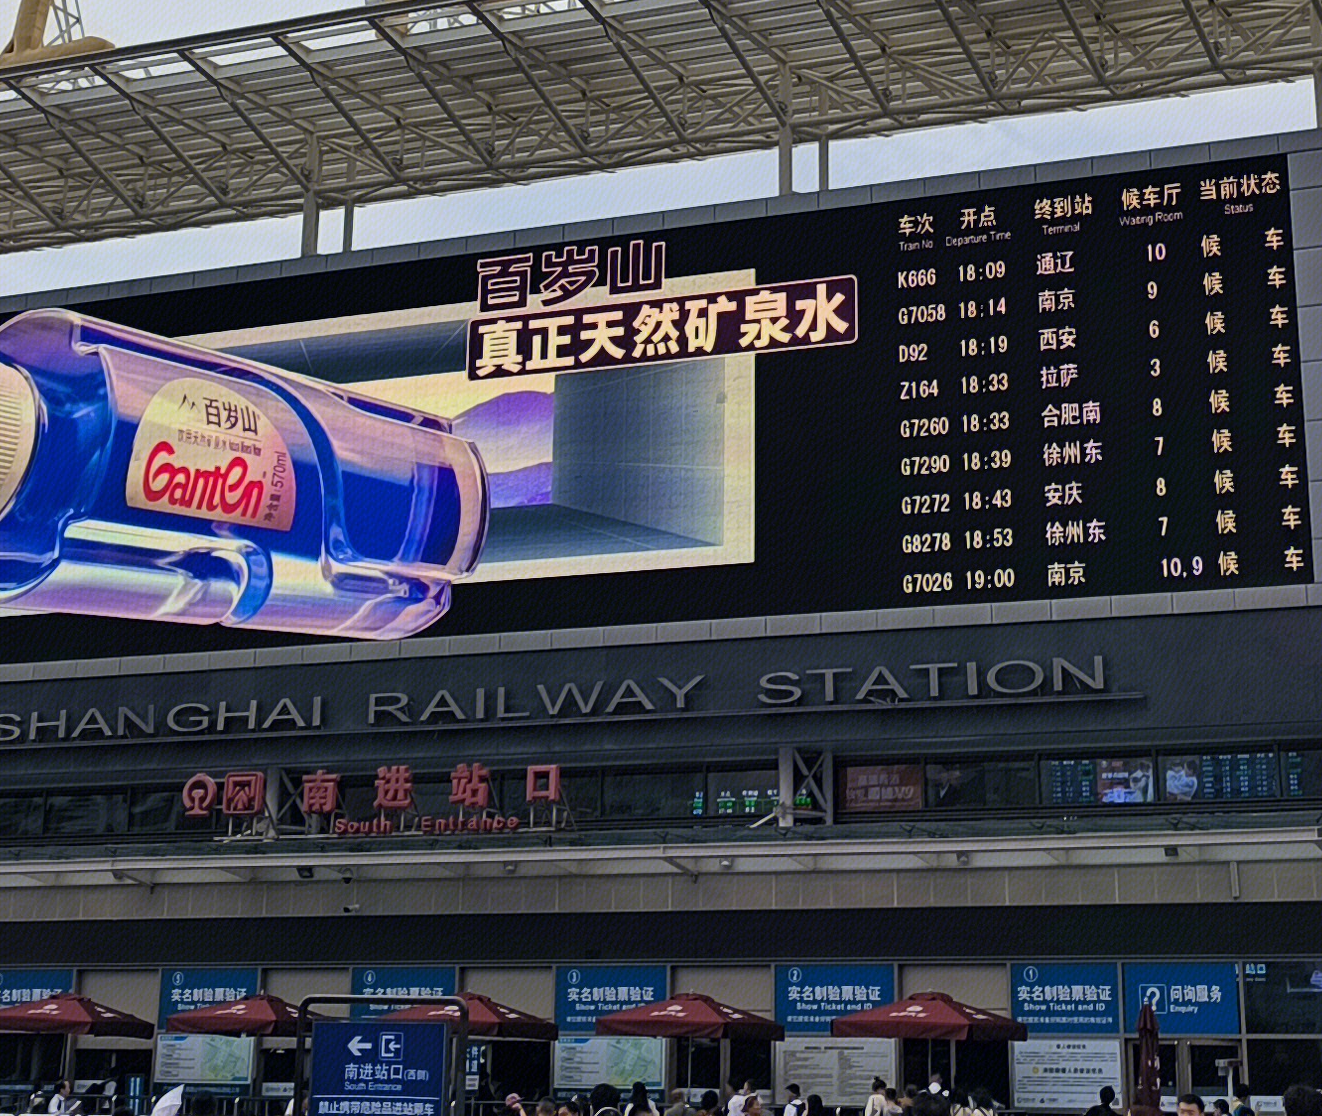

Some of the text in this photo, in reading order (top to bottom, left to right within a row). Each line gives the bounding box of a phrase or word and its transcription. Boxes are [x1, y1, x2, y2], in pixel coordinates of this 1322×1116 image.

[1200, 171, 1280, 199] 当前状态
[1035, 193, 1092, 219] 终到站
[1122, 183, 1181, 213] 候车厅
[960, 205, 996, 229] 开点
[1156, 212, 1182, 222] Room
[1225, 204, 1253, 214] Status
[899, 213, 933, 236] 车次
[1042, 222, 1079, 234] Terminal
[1148, 243, 1165, 261] 10
[959, 261, 1005, 281] 18:09
[1037, 251, 1074, 274] 通辽
[477, 240, 666, 314] 百岁山
[898, 268, 935, 288] K666
[1148, 281, 1157, 299] 9
[959, 298, 1005, 318] 18:14
[1039, 288, 1075, 313] 南京
[899, 304, 945, 324] G7058
[475, 284, 850, 377] 真正天然矿泉水
[1039, 326, 1076, 351] 西安
[1150, 320, 1159, 338] 6
[899, 344, 927, 362] D92
[961, 336, 1007, 356] 18:19
[1040, 364, 1078, 389] 拉萨
[1151, 359, 1160, 376] 3
[900, 380, 938, 399] Z164
[962, 373, 1008, 393] 18:33
[203, 397, 258, 435] 百岁山
[1042, 401, 1100, 428] 合肥南
[1153, 398, 1162, 416] 8
[901, 417, 948, 437] G7260
[963, 411, 1009, 432] 18:33
[1043, 439, 1102, 466] 徐州东
[1155, 437, 1163, 455] 7
[901, 455, 949, 475] G7290
[963, 450, 1011, 470] 18:39
[1045, 481, 1082, 506] 安庆
[1157, 478, 1166, 496] 8
[902, 494, 950, 514] G7272
[964, 489, 1011, 510] 18:43
[1046, 519, 1106, 545] 徐州东
[1159, 517, 1167, 536] 7
[903, 533, 950, 553] G8278
[965, 528, 1012, 549] 18:53
[1048, 561, 1085, 586] 南京
[1162, 556, 1202, 577] 10,9
[903, 572, 952, 593] G7026
[967, 568, 1014, 589] 19:00
[367, 675, 706, 724] RAILWAY
[757, 655, 1104, 704] STATION
[301, 762, 560, 814] 南进站口
[334, 815, 520, 835] South Entrance
[567, 987, 655, 1002] 实名制验票验证
[787, 985, 882, 1001] 实名制验票验证
[1017, 985, 1112, 1001] 实名制验票验证
[1170, 985, 1222, 1003] 问询服务
[796, 1002, 817, 1011] Show
[819, 1002, 845, 1011] Ticket
[1023, 1002, 1106, 1011] Show Ticket and ID
[1170, 1005, 1198, 1013] Enquiry
